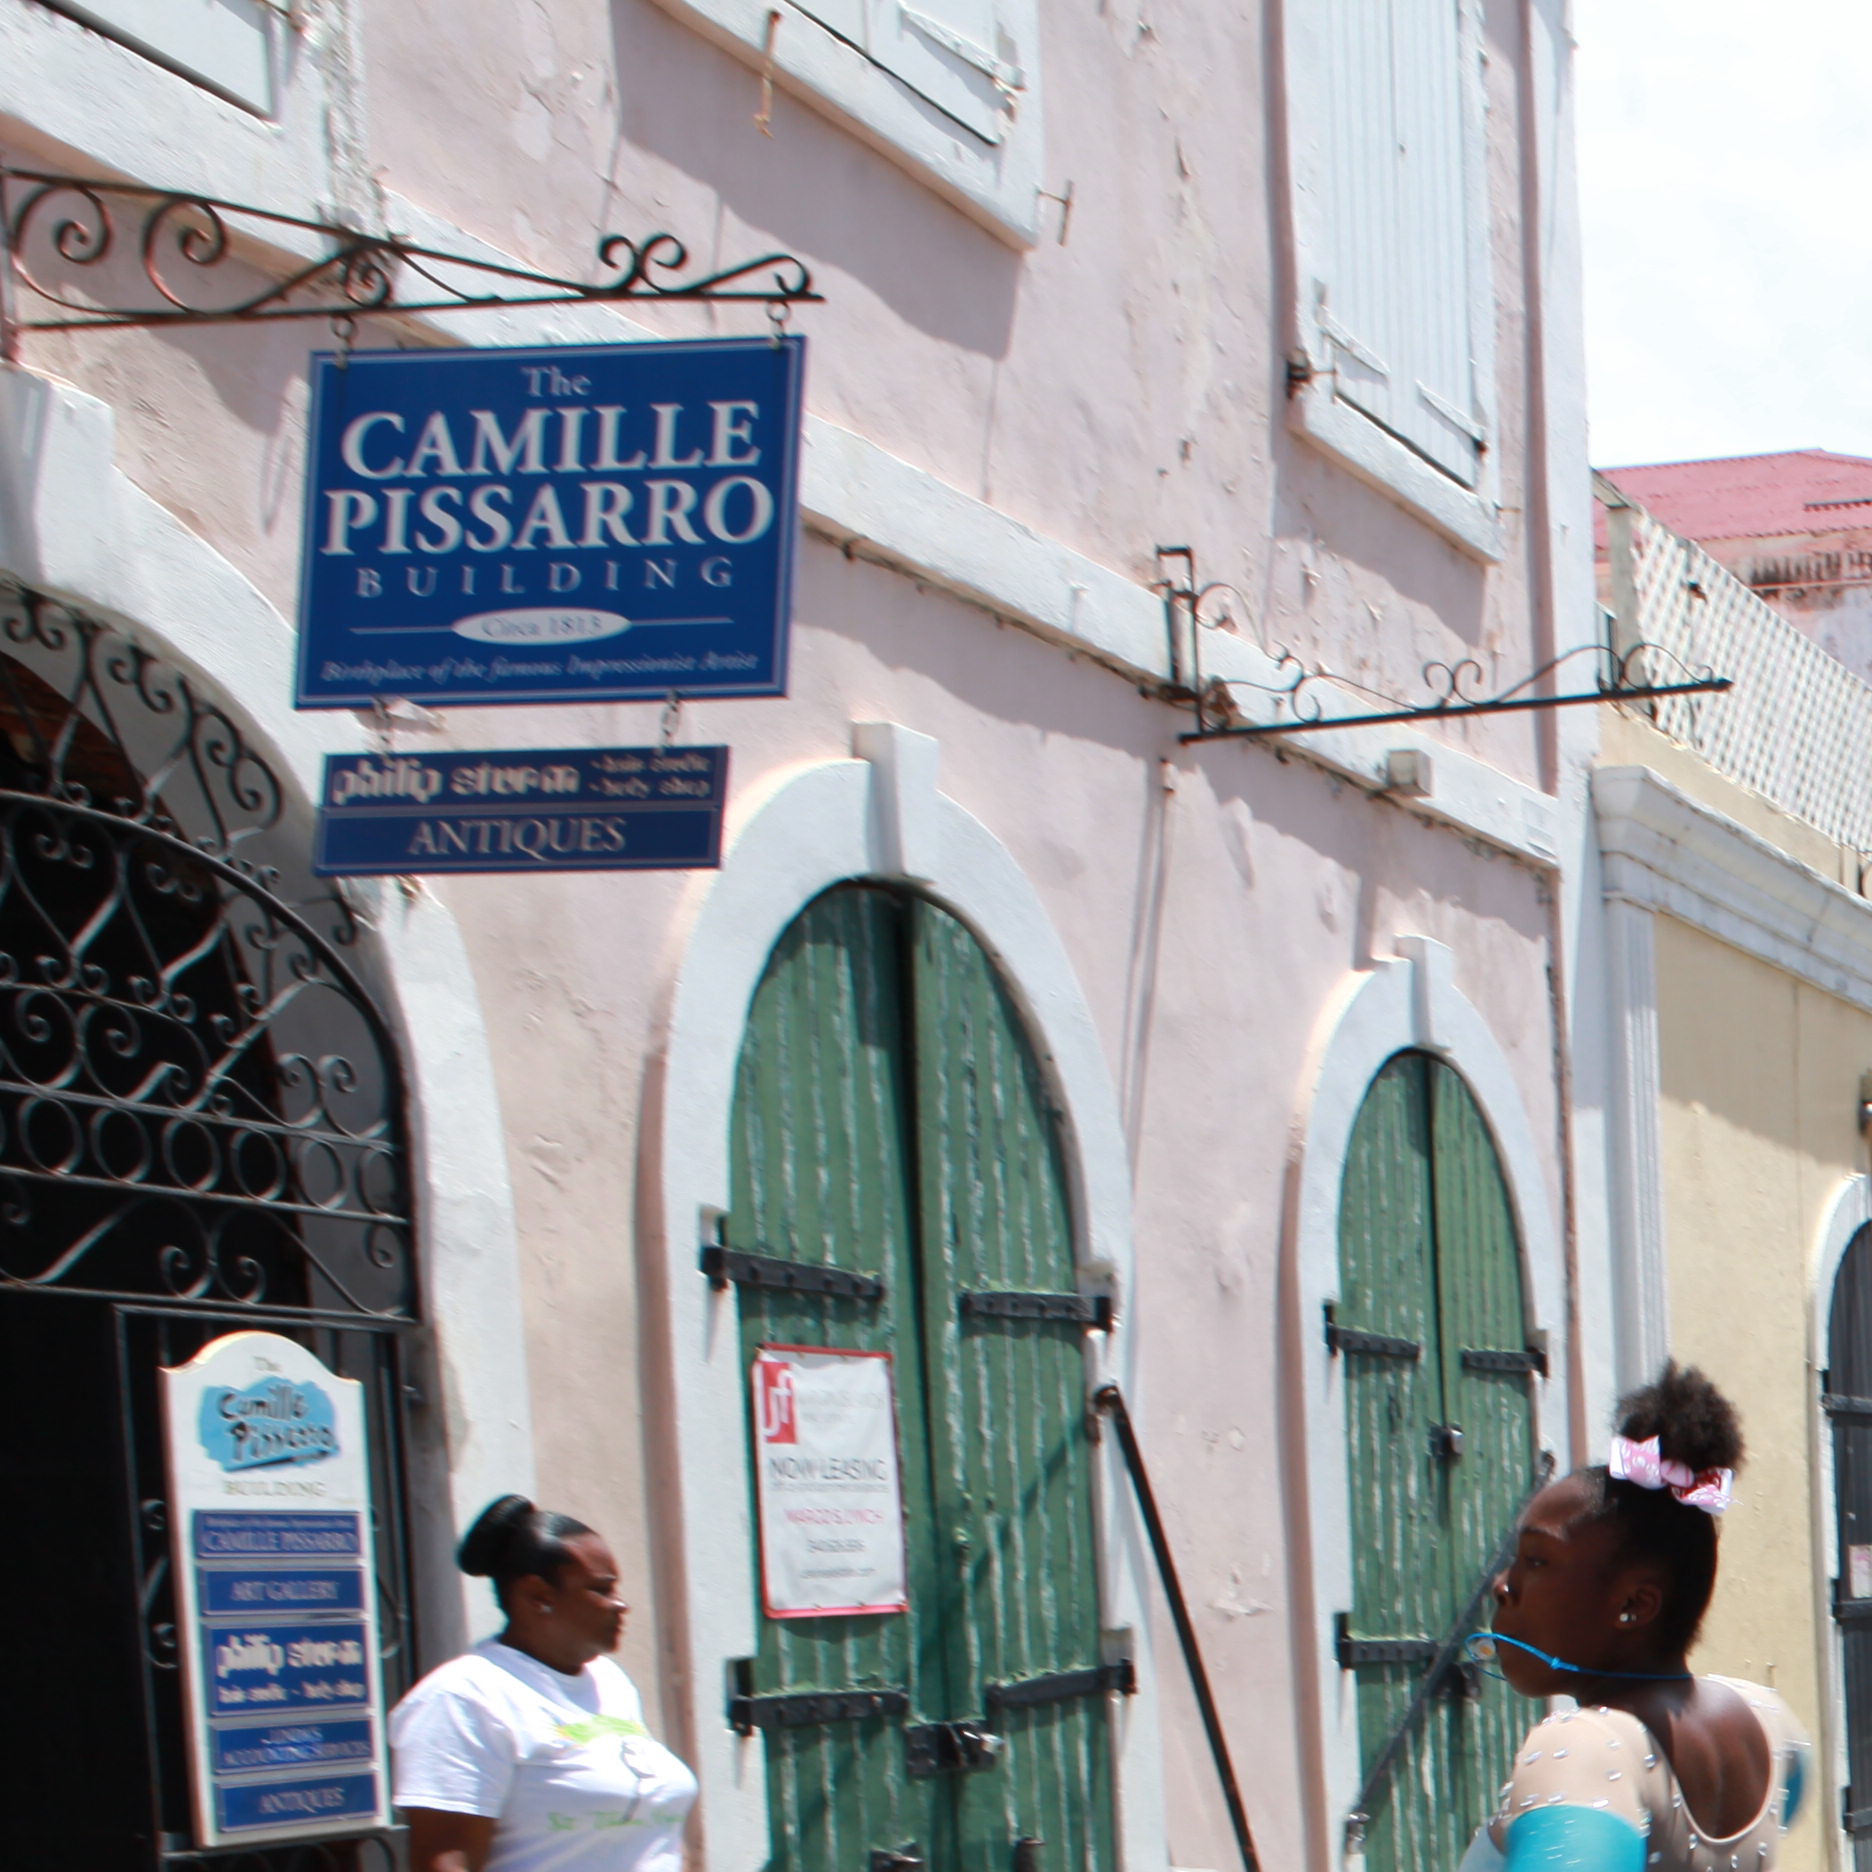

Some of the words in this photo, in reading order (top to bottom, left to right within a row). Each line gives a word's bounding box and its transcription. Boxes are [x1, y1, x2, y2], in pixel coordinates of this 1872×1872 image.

[521, 364, 592, 397] The
[341, 400, 762, 481] CAMILLE
[320, 475, 774, 556] PISSARRO
[357, 556, 734, 598] BUILDING
[482, 616, 540, 638] Circa
[321, 659, 426, 686] Birthplace
[428, 656, 453, 685] of
[452, 657, 488, 678] the
[488, 655, 562, 685] famous
[332, 756, 442, 805] philip
[407, 815, 627, 861] ANTIQUES
[219, 1384, 308, 1419] Camille
[769, 1457, 820, 1480] NOW
[821, 1458, 888, 1481] LEASING
[258, 1787, 345, 1813] ANTIQUES
